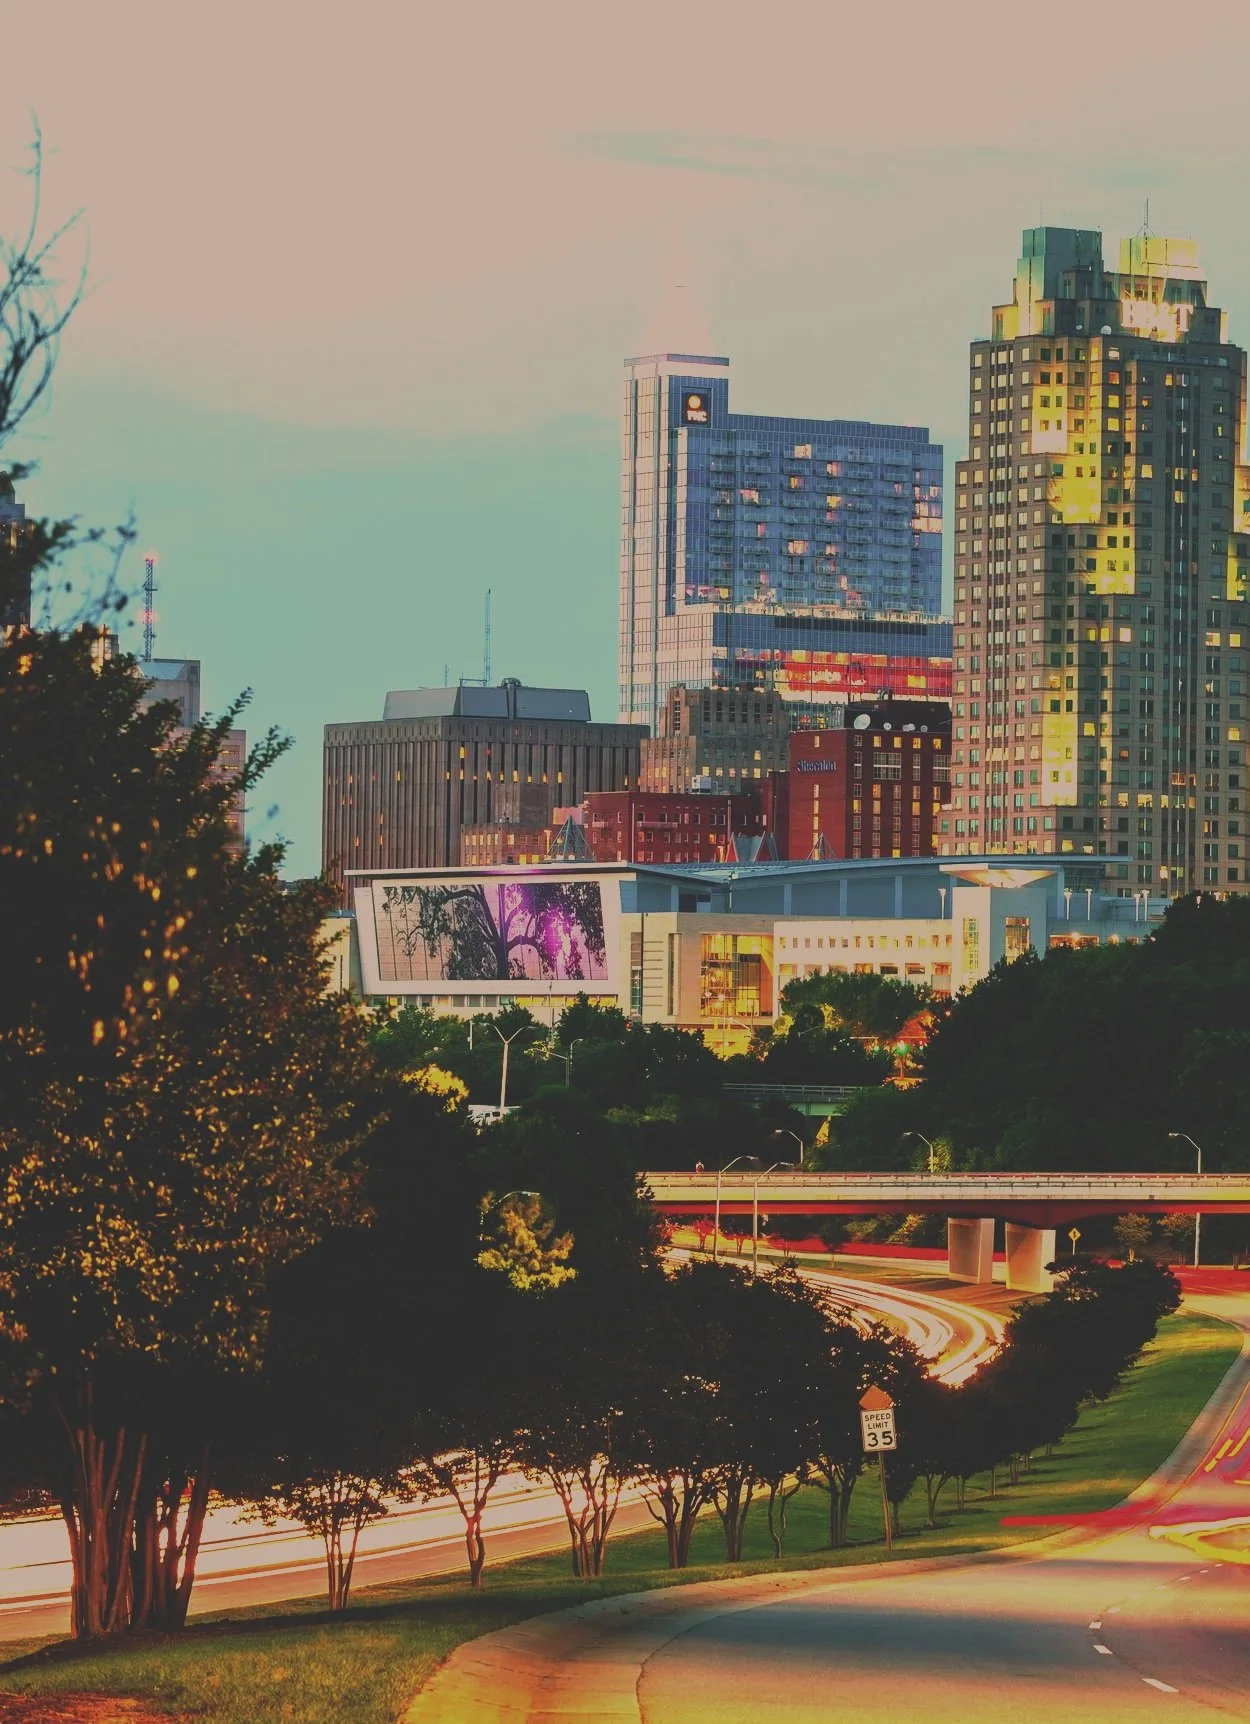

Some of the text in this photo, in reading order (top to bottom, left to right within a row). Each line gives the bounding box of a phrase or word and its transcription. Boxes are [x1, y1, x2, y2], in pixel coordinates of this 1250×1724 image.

[864, 1412, 891, 1421] SPEED
[867, 1421, 888, 1430] LIMIT
[867, 1430, 893, 1447] 35
